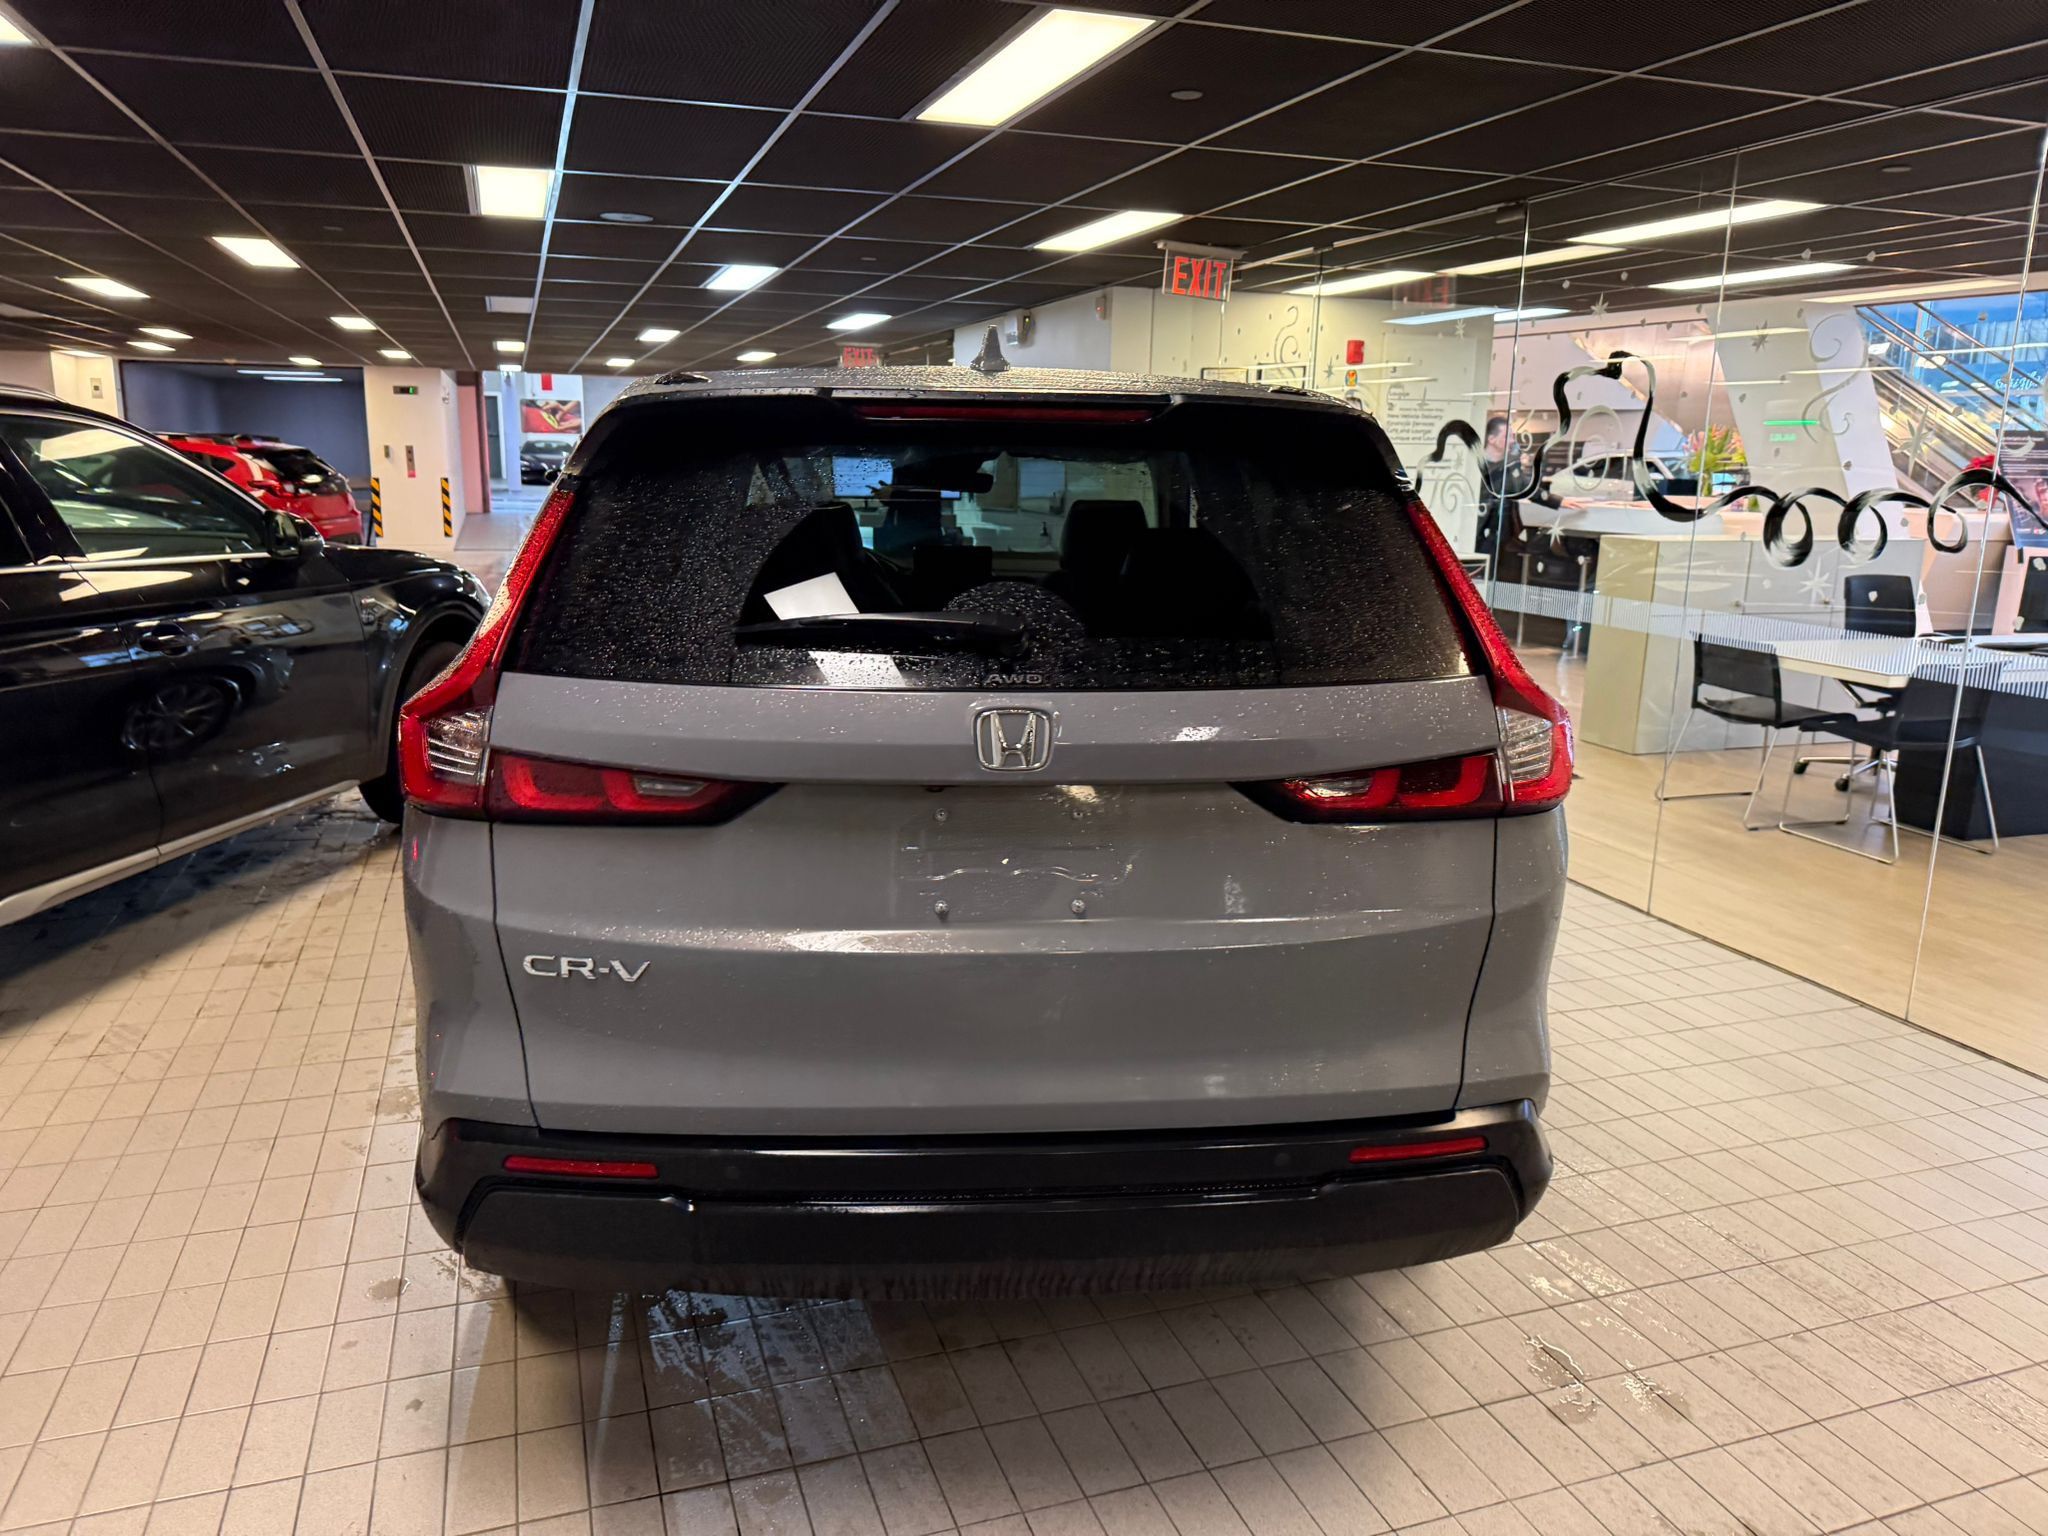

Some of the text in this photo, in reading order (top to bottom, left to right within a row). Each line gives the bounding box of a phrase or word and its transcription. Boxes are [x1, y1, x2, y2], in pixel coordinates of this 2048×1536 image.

[1172, 256, 1227, 299] EXIT
[843, 346, 874, 368] EXIT
[985, 673, 1042, 684] AWD
[523, 955, 651, 982] CR-V
